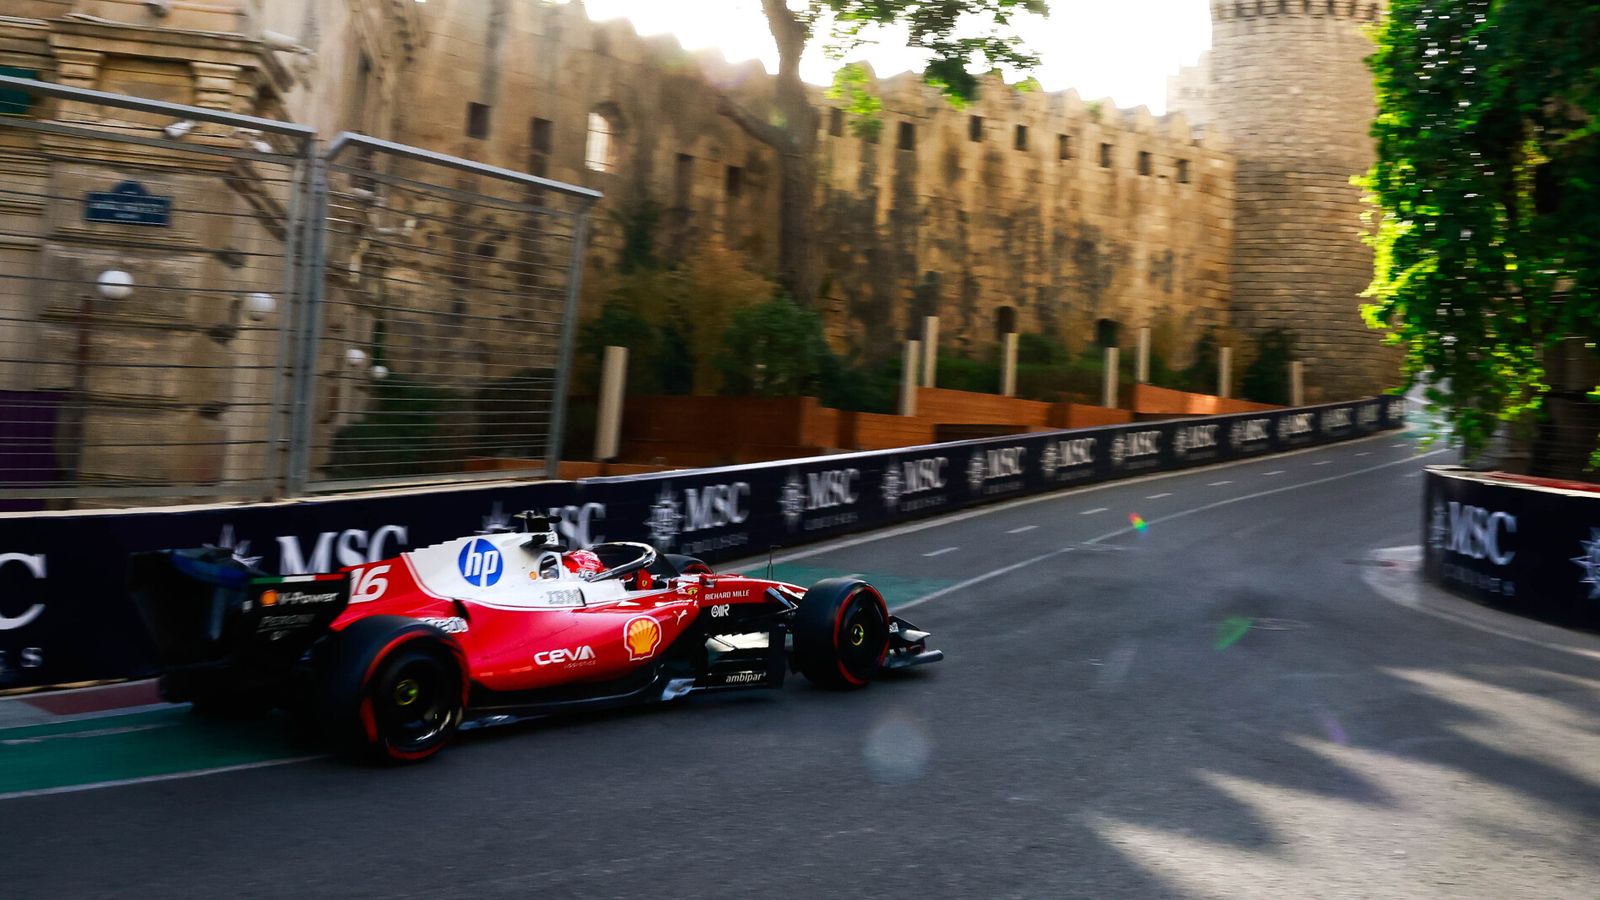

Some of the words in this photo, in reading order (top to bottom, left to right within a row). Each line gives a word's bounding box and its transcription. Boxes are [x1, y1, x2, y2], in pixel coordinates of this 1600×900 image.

[984, 447, 1027, 479] MSC
[1056, 438, 1097, 467] MSC
[805, 468, 860, 510] MSC
[901, 456, 949, 495] MSC
[549, 502, 607, 550] SC
[682, 481, 750, 532] MSC
[276, 525, 409, 575] MSC
[1446, 501, 1518, 566] MSC
[464, 537, 500, 588] hp
[277, 591, 339, 606] V-Power
[348, 565, 392, 604] 16
[546, 589, 581, 604] IBM
[704, 591, 731, 600] RICHARD
[732, 589, 750, 598] MILLE
[534, 645, 596, 666] CEVA
[726, 672, 762, 683] ambipar
